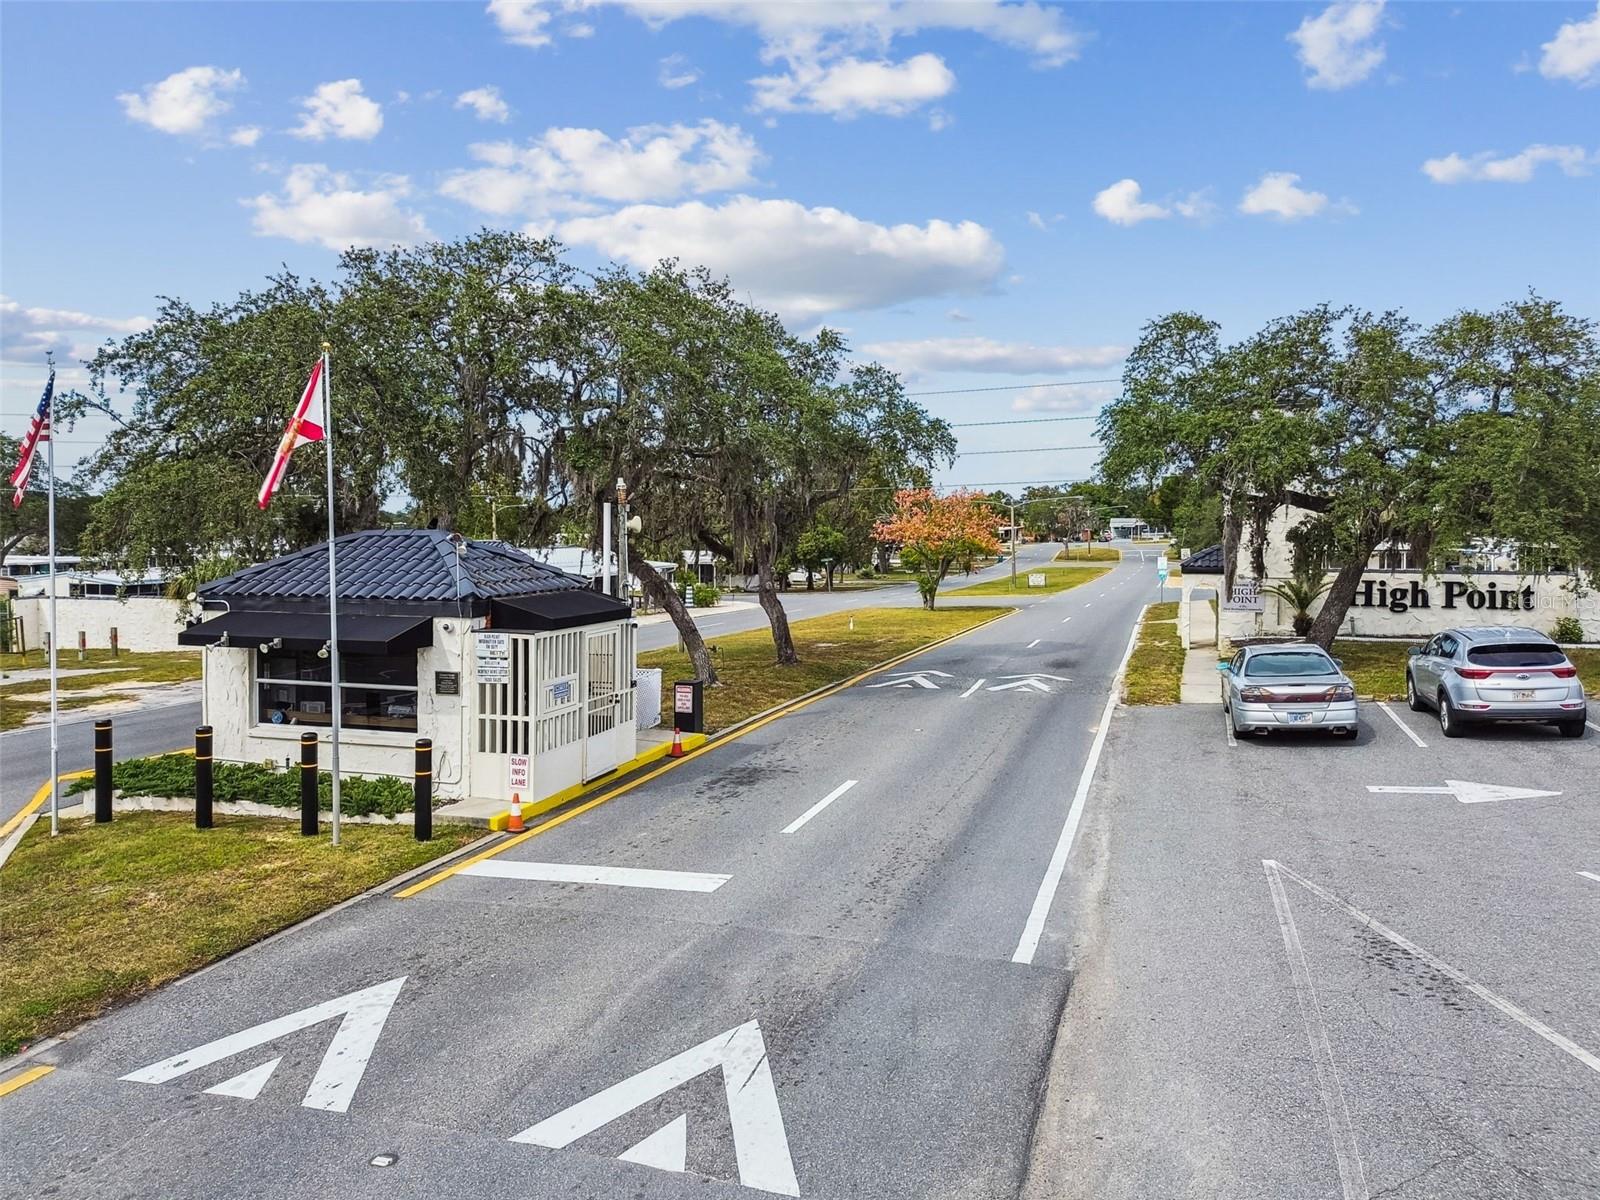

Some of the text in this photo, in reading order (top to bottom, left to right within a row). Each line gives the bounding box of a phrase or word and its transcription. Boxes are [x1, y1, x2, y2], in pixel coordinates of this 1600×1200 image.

[1232, 596, 1260, 604] OINT
[1350, 580, 1535, 613] High Point
[511, 757, 527, 766] SLOW
[511, 768, 526, 776] INFO
[511, 778, 527, 786] LANE
